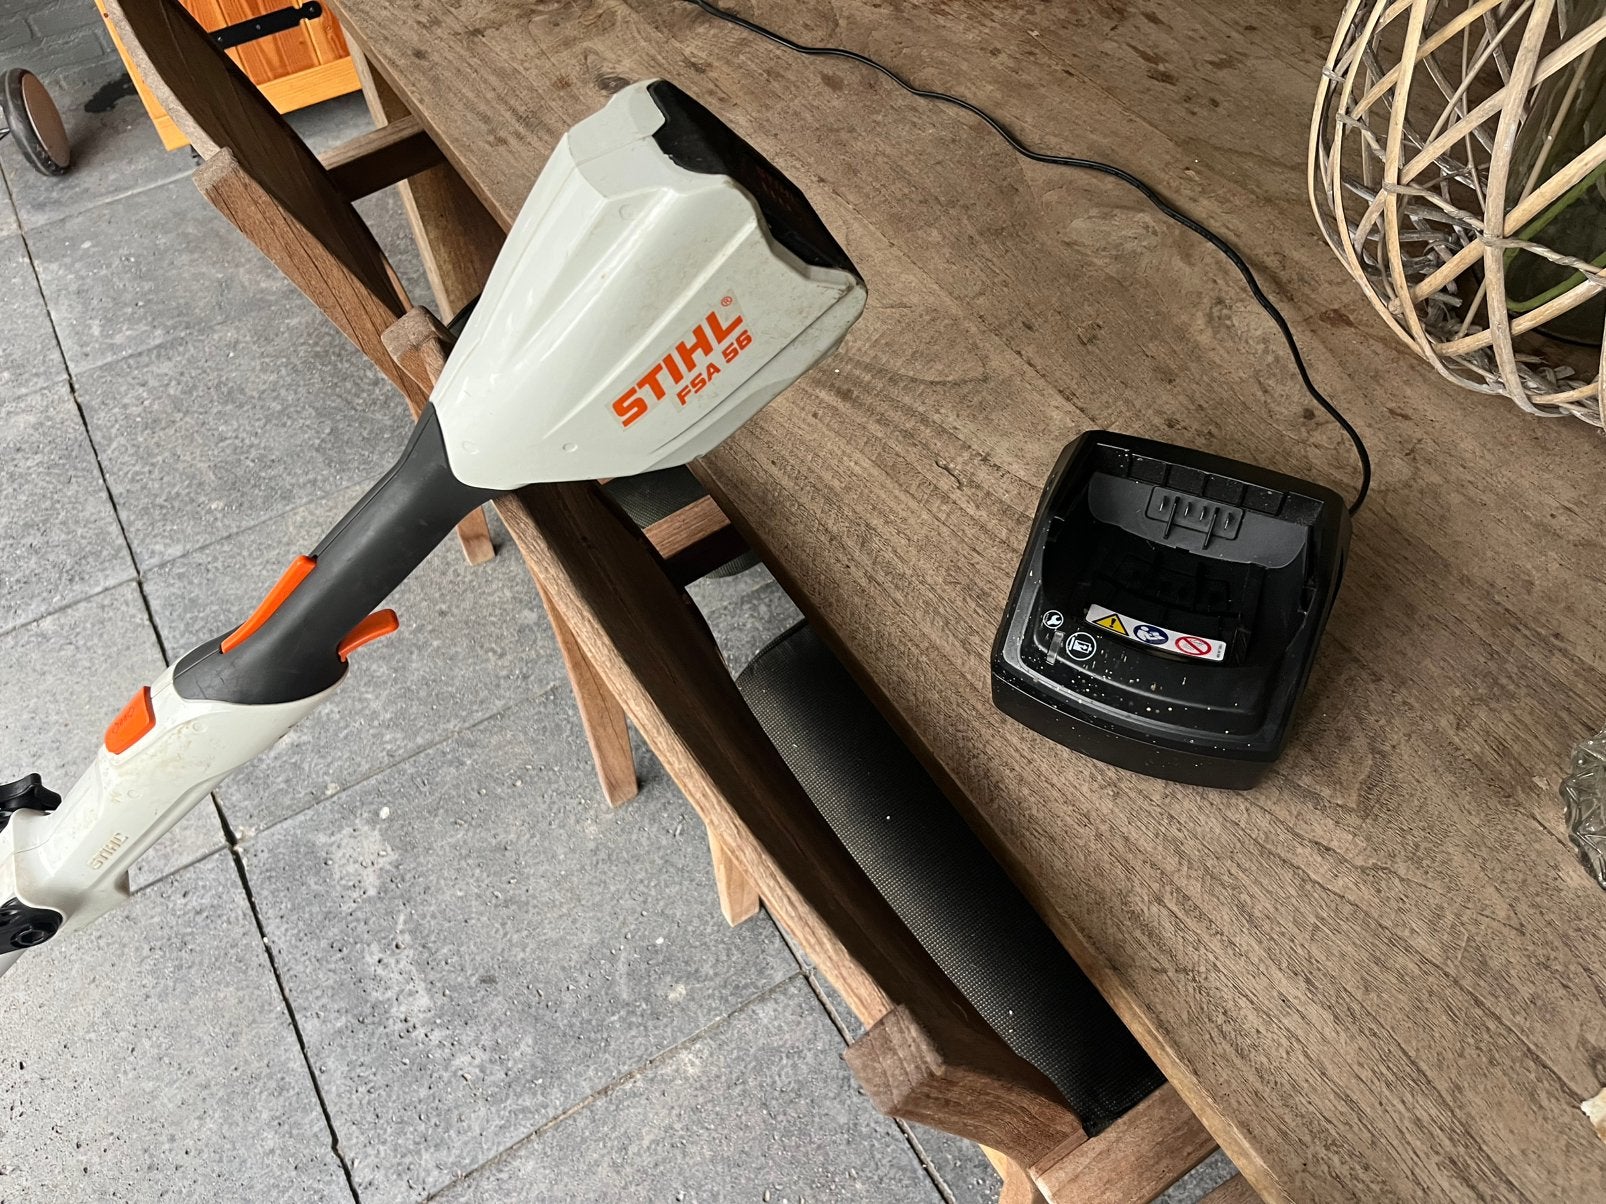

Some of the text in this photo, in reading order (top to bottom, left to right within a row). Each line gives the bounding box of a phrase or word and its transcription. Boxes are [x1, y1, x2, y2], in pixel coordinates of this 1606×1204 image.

[676, 329, 753, 406] FSA 56
[88, 832, 129, 870] STIHL
